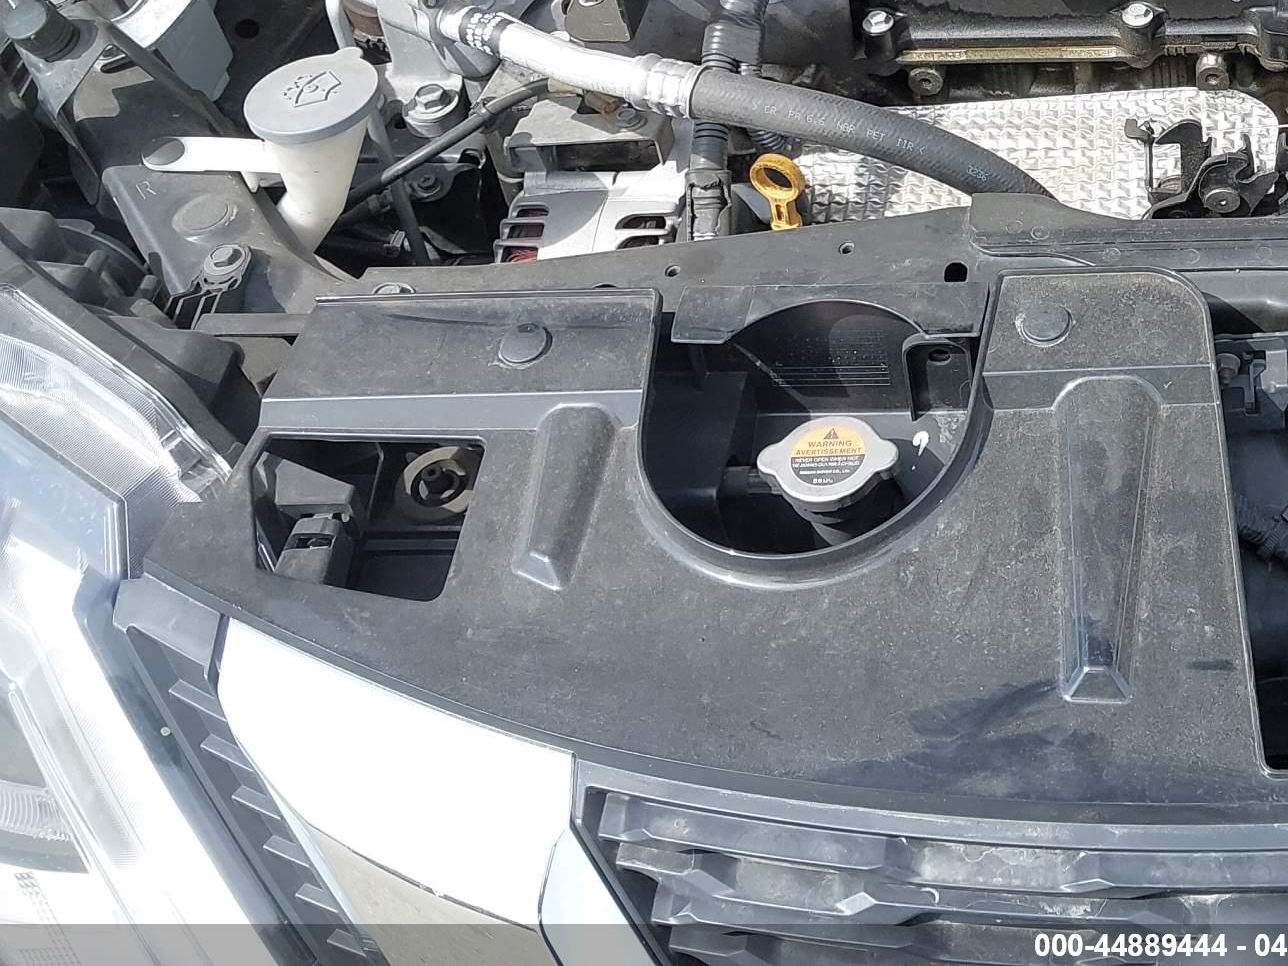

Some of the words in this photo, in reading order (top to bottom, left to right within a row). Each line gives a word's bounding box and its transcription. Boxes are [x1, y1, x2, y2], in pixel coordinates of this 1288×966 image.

[764, 105, 777, 115] CR
[866, 128, 886, 142] PET
[136, 180, 157, 200] R
[808, 440, 852, 448] WARNING
[795, 447, 862, 456] AVERTISSEMENT
